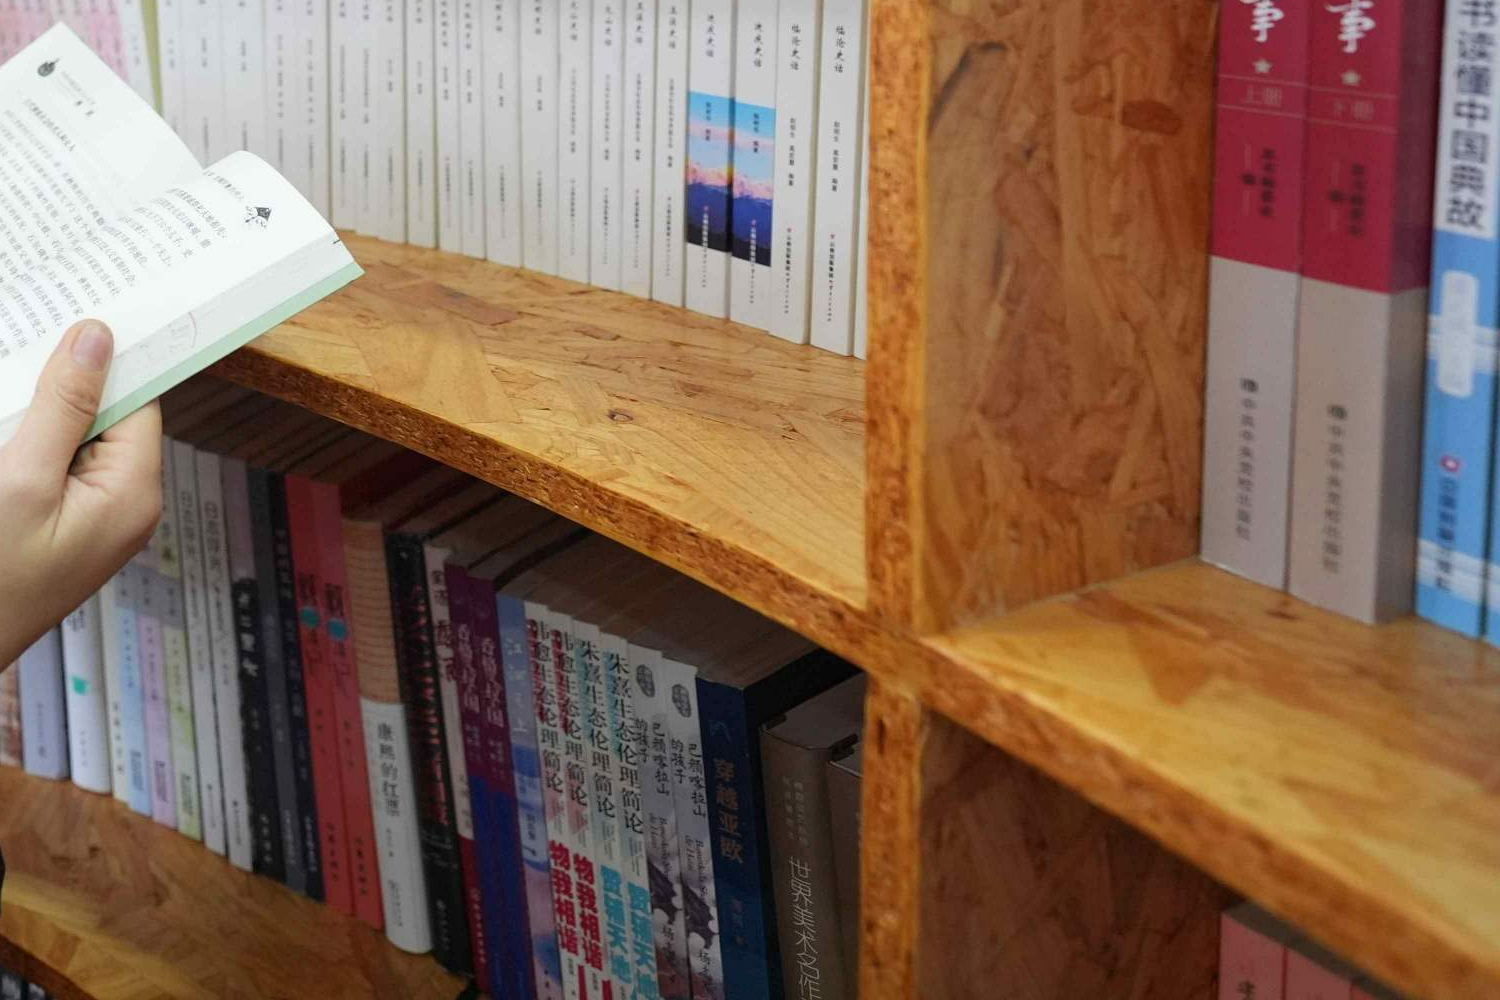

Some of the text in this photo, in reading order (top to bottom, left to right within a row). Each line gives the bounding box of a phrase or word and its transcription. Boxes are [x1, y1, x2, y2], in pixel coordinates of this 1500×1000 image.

[790, 24, 801, 71] 临沧史话
[834, 25, 846, 73] 临沧史话
[579, 638, 616, 819] 朱熹生态伦理简论
[608, 651, 645, 835] 朱熹生态伦理简论
[651, 721, 669, 797] 巴颜喀拉山
[671, 738, 685, 784] 的孩子
[687, 742, 707, 819] 巴颜喀拉山
[714, 758, 742, 863] 穿越亚欧
[549, 840, 580, 958] 物我相谐
[573, 853, 604, 971] 物我相谐
